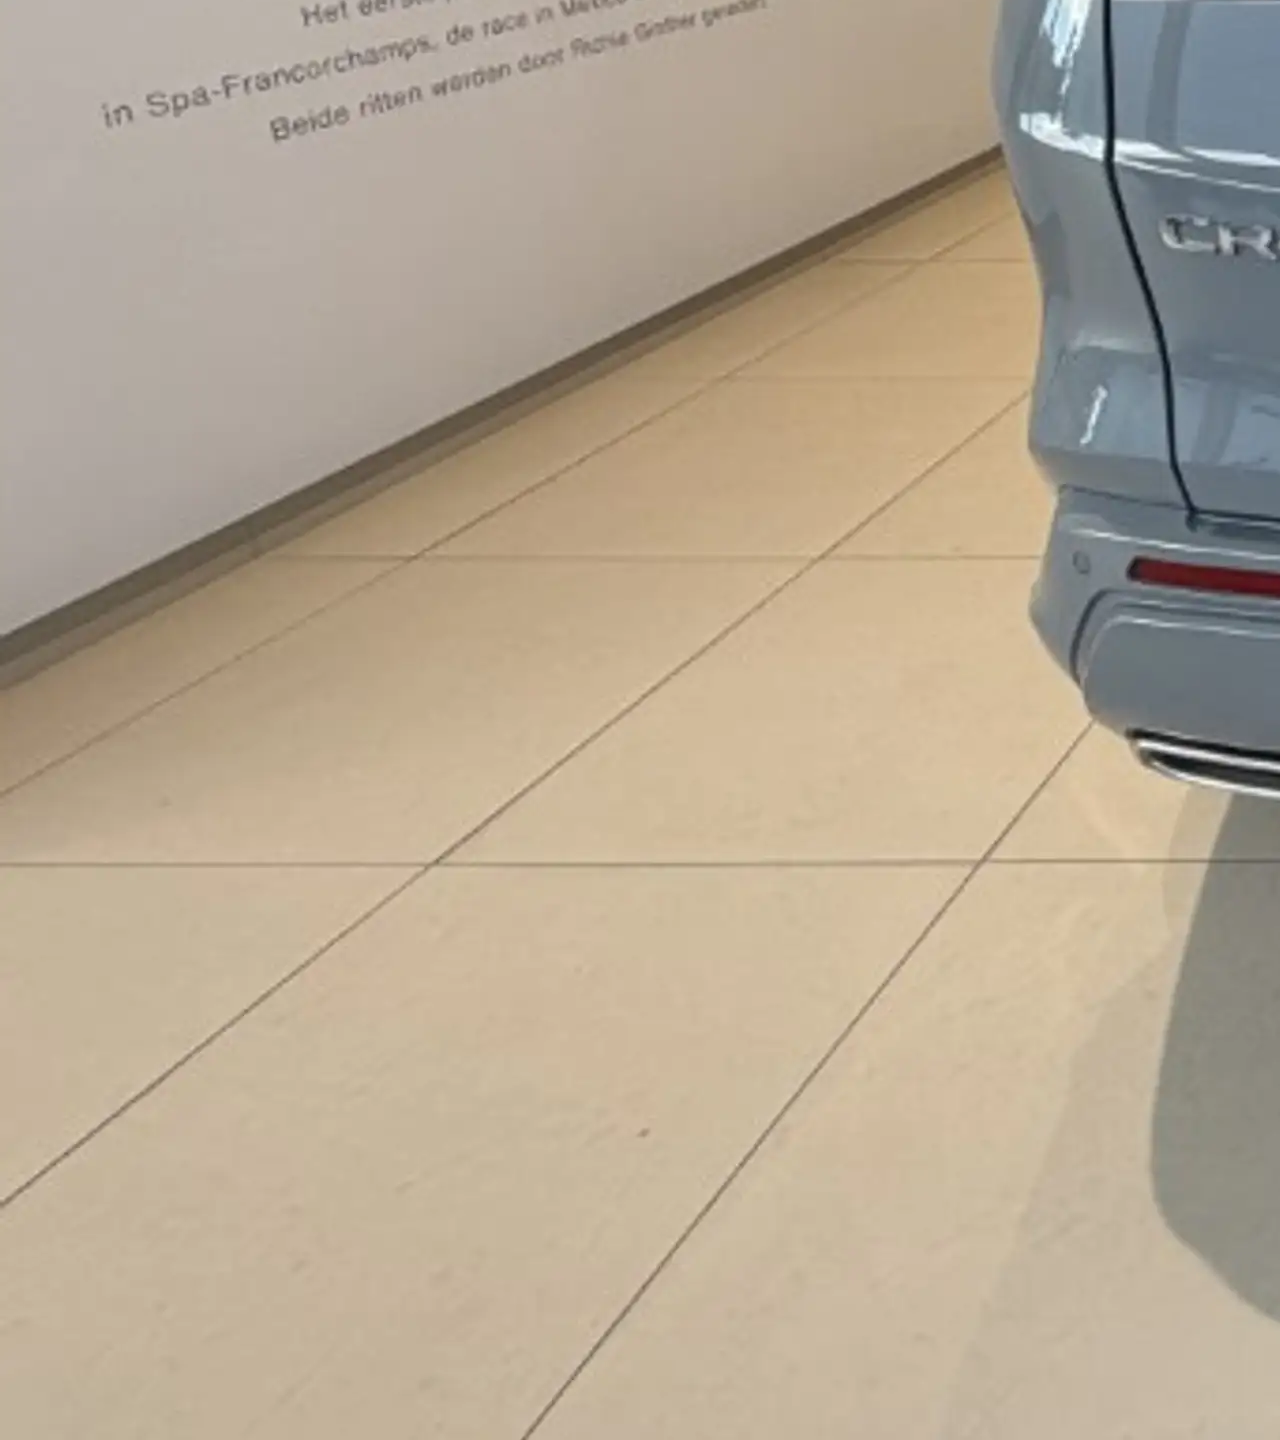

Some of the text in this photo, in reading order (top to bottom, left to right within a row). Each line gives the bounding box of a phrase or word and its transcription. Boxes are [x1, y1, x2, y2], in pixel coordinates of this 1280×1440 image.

[300, 0, 348, 28] Het
[99, 101, 134, 129] in
[445, 22, 474, 47] de
[481, 11, 529, 39] race
[534, 5, 554, 25] in
[269, 104, 350, 144] Beide
[358, 84, 424, 120] ritten
[517, 49, 565, 75] door
